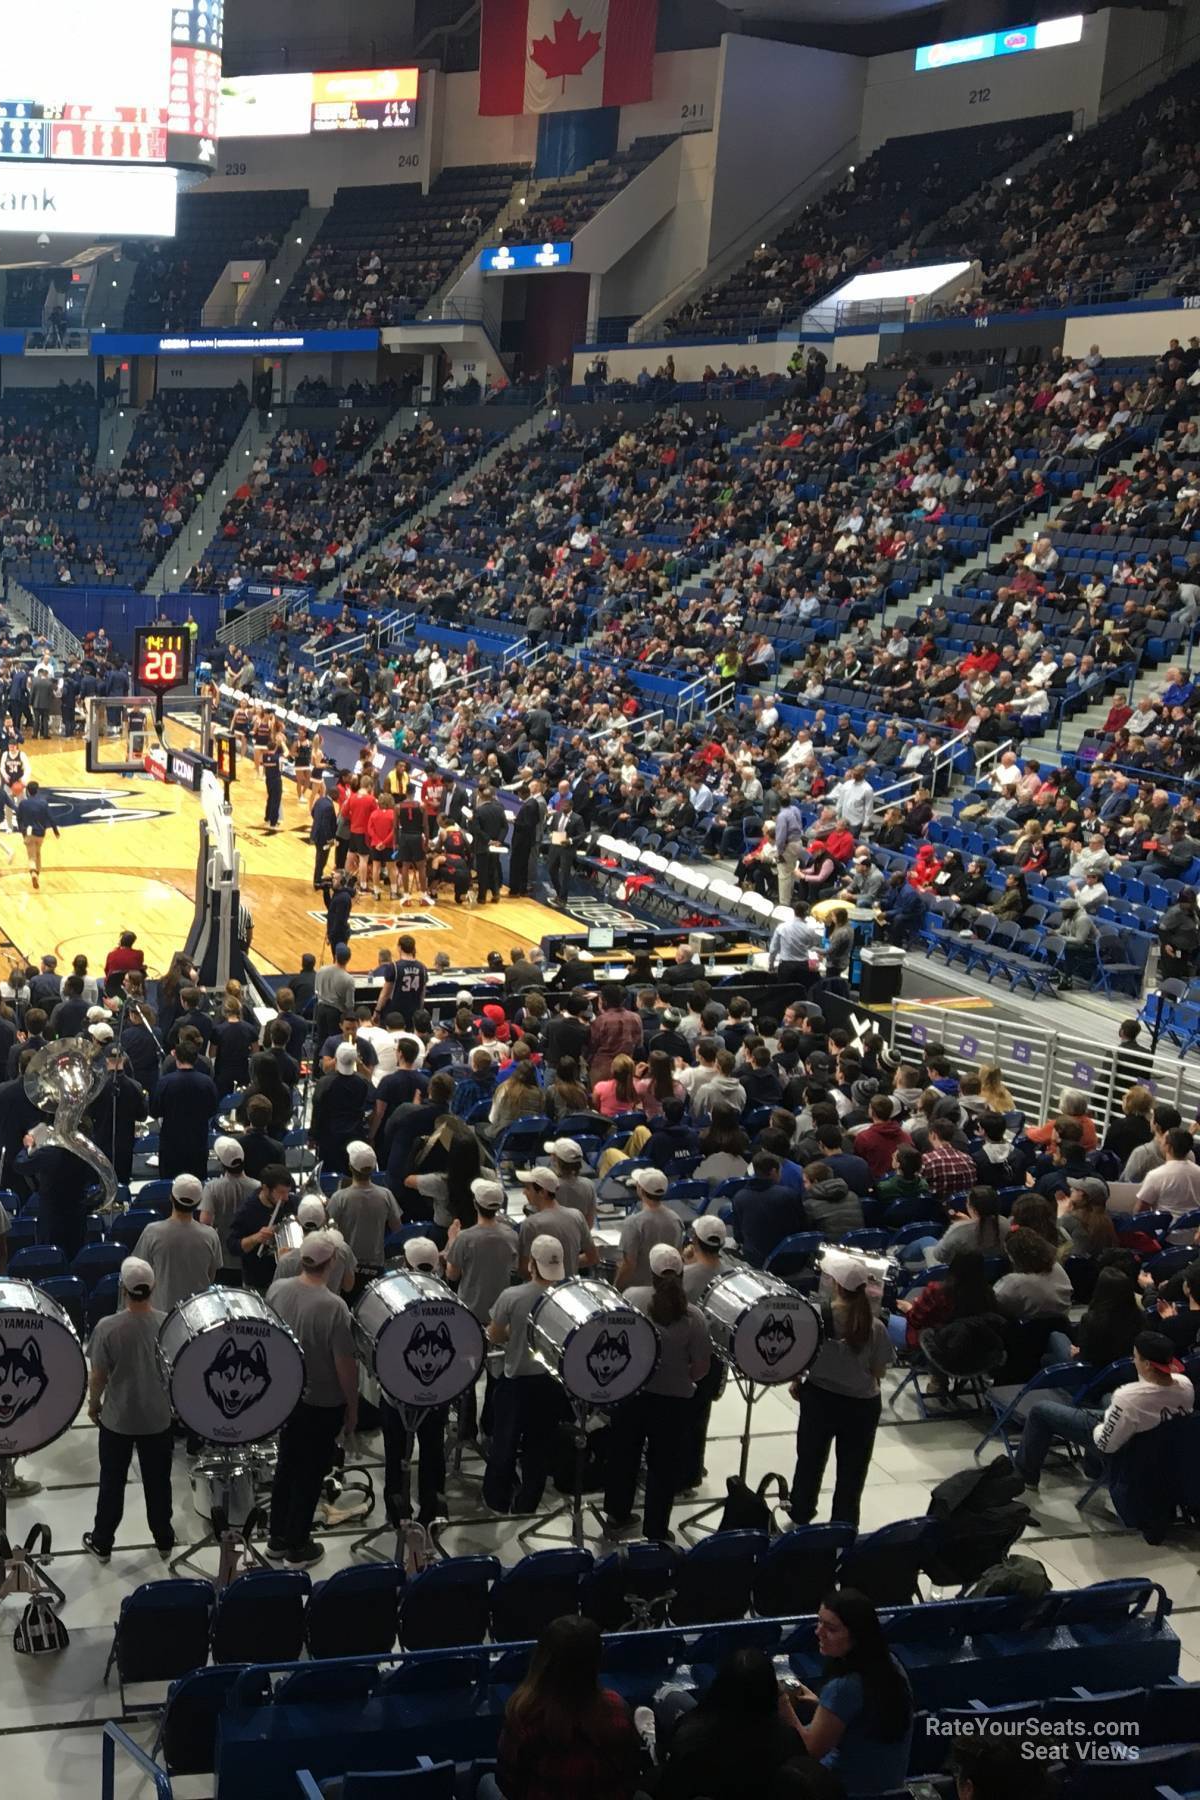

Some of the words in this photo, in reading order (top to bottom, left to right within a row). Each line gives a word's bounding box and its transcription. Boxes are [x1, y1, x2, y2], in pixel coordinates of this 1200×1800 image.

[969, 88, 991, 104] 212
[398, 154, 420, 168] 240
[225, 162, 247, 176] 239
[975, 317, 988, 328] 114
[147, 635, 181, 650] 14:11
[145, 651, 177, 680] 20
[172, 756, 195, 782] UCONN
[402, 975, 420, 992] 34
[422, 1306, 455, 1317] YAMAHA
[773, 1301, 799, 1311] YAMAHA
[4, 1319, 44, 1331] YAMAHA
[607, 1316, 636, 1326] YAMAHA
[235, 1325, 272, 1338] YAMAHA
